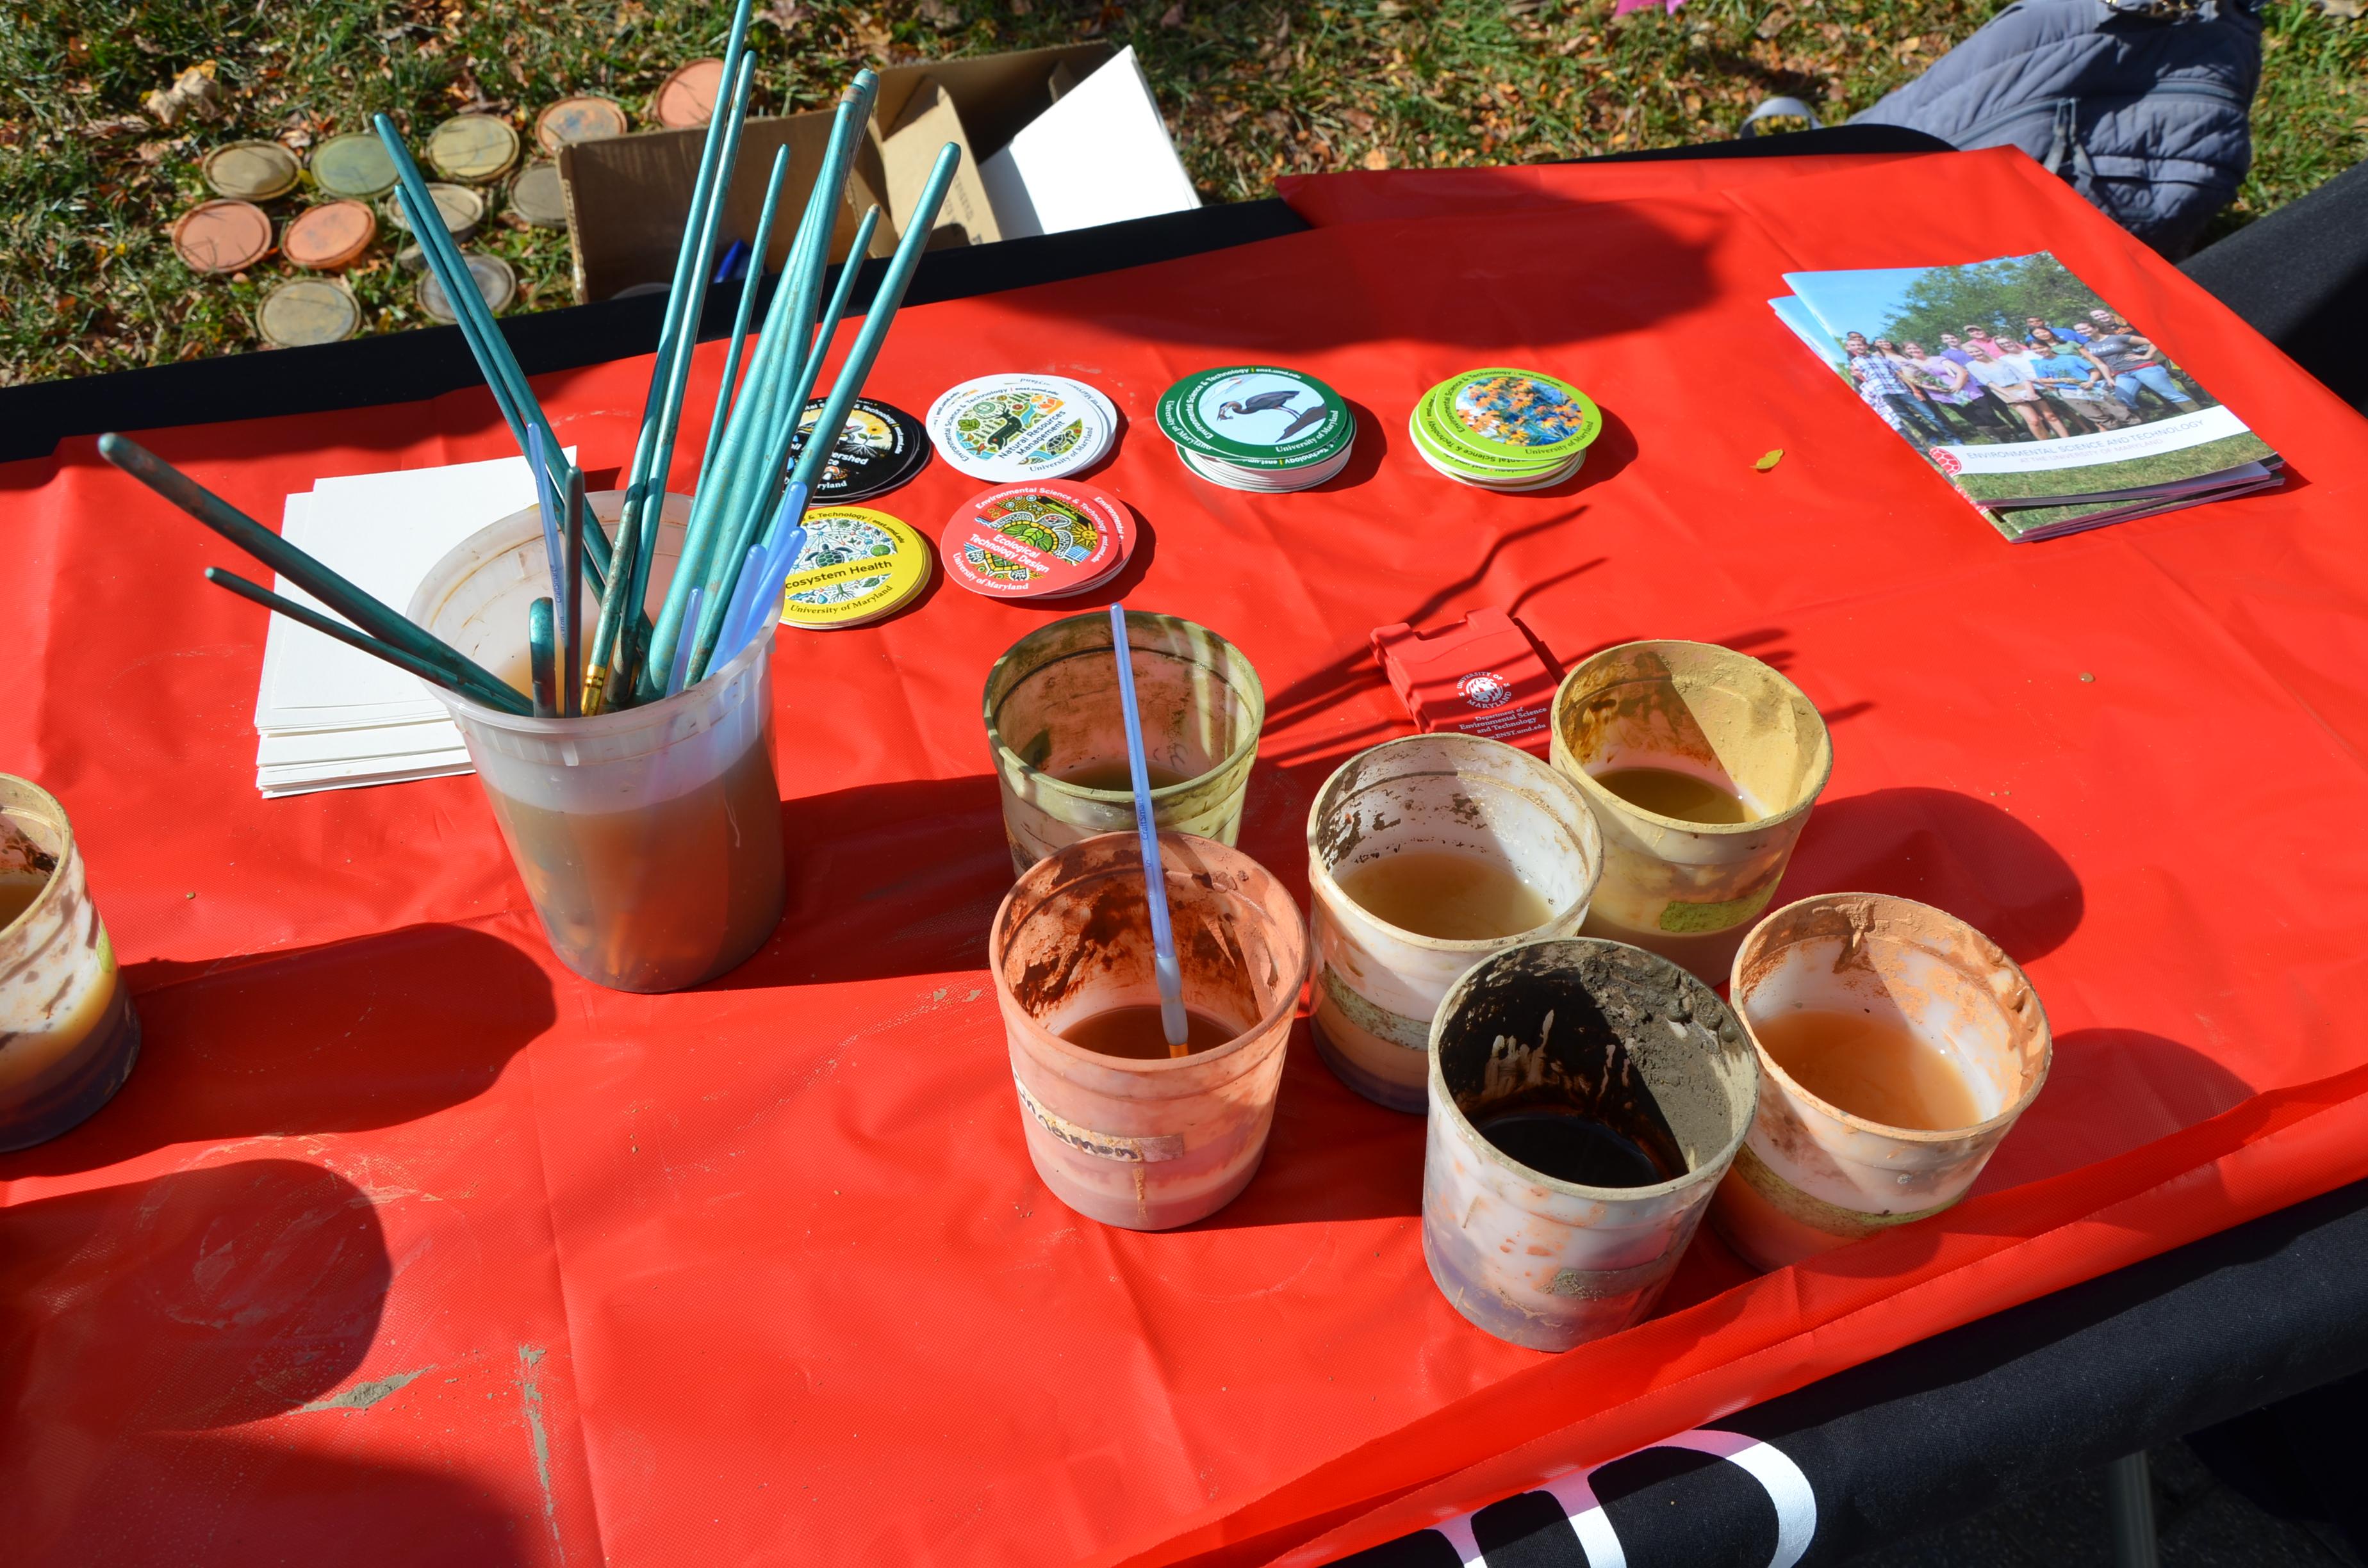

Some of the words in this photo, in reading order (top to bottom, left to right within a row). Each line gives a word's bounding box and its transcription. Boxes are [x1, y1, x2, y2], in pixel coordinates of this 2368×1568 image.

[1206, 368, 1249, 383] Technology
[1468, 370, 1511, 379] Technology
[1187, 385, 1203, 404] Science
[1445, 380, 1463, 401] Science
[862, 405, 896, 424] Technology
[946, 408, 961, 427] Science
[966, 388, 1008, 404] Technology
[1165, 400, 1176, 427] University
[1172, 424, 1180, 433] of
[1443, 400, 1465, 433] Environmental
[1186, 403, 1213, 439] Environmental
[1275, 437, 1317, 453] University
[1315, 430, 1323, 439] of
[1320, 410, 1338, 436] Maryland
[1426, 420, 1454, 448] Technology
[998, 434, 1028, 459] Natural
[1028, 410, 1066, 438] Resources
[1015, 420, 1065, 456] Management
[1525, 444, 1567, 455] University
[1566, 437, 1575, 446] of
[1575, 421, 1593, 443] Maryland
[1966, 447, 2059, 460] ENVIRONMENTAL
[2059, 441, 2105, 453] SCIENCE
[2107, 436, 2130, 446] AND
[2128, 419, 2205, 443] TECHNOLOGY
[833, 453, 869, 466] ershed
[1029, 455, 1070, 472] University
[1069, 448, 1079, 457] of
[1078, 427, 1093, 451] Maryland
[1284, 448, 1329, 464] Technology
[1463, 448, 1497, 462] Science
[2049, 449, 2101, 462] UNIVERSITY
[2114, 438, 2164, 453] MARYLAND
[818, 481, 848, 490] ryland
[975, 487, 1037, 510] Environmental
[1039, 487, 1072, 501] Science
[1080, 502, 1108, 534] Technology
[1093, 496, 1124, 535] Environmental
[873, 519, 905, 544] enst.umd.edu
[969, 534, 1017, 560] Technology
[1017, 555, 1050, 574] Design
[992, 534, 1041, 559] Ecological
[785, 570, 846, 589] cosystem
[850, 560, 892, 575] Health
[953, 551, 978, 581] University
[976, 577, 986, 585] of
[984, 580, 1029, 591] Maryland
[791, 604, 838, 614] University
[851, 585, 893, 608] Maryland
[1457, 671, 1492, 689] UNIVERSITY
[1467, 691, 1512, 708] MARYLAND
[1459, 715, 1517, 730] Environmental
[1517, 707, 1547, 719] Science
[1475, 710, 1515, 721] Department
[1492, 717, 1536, 731] Technology
